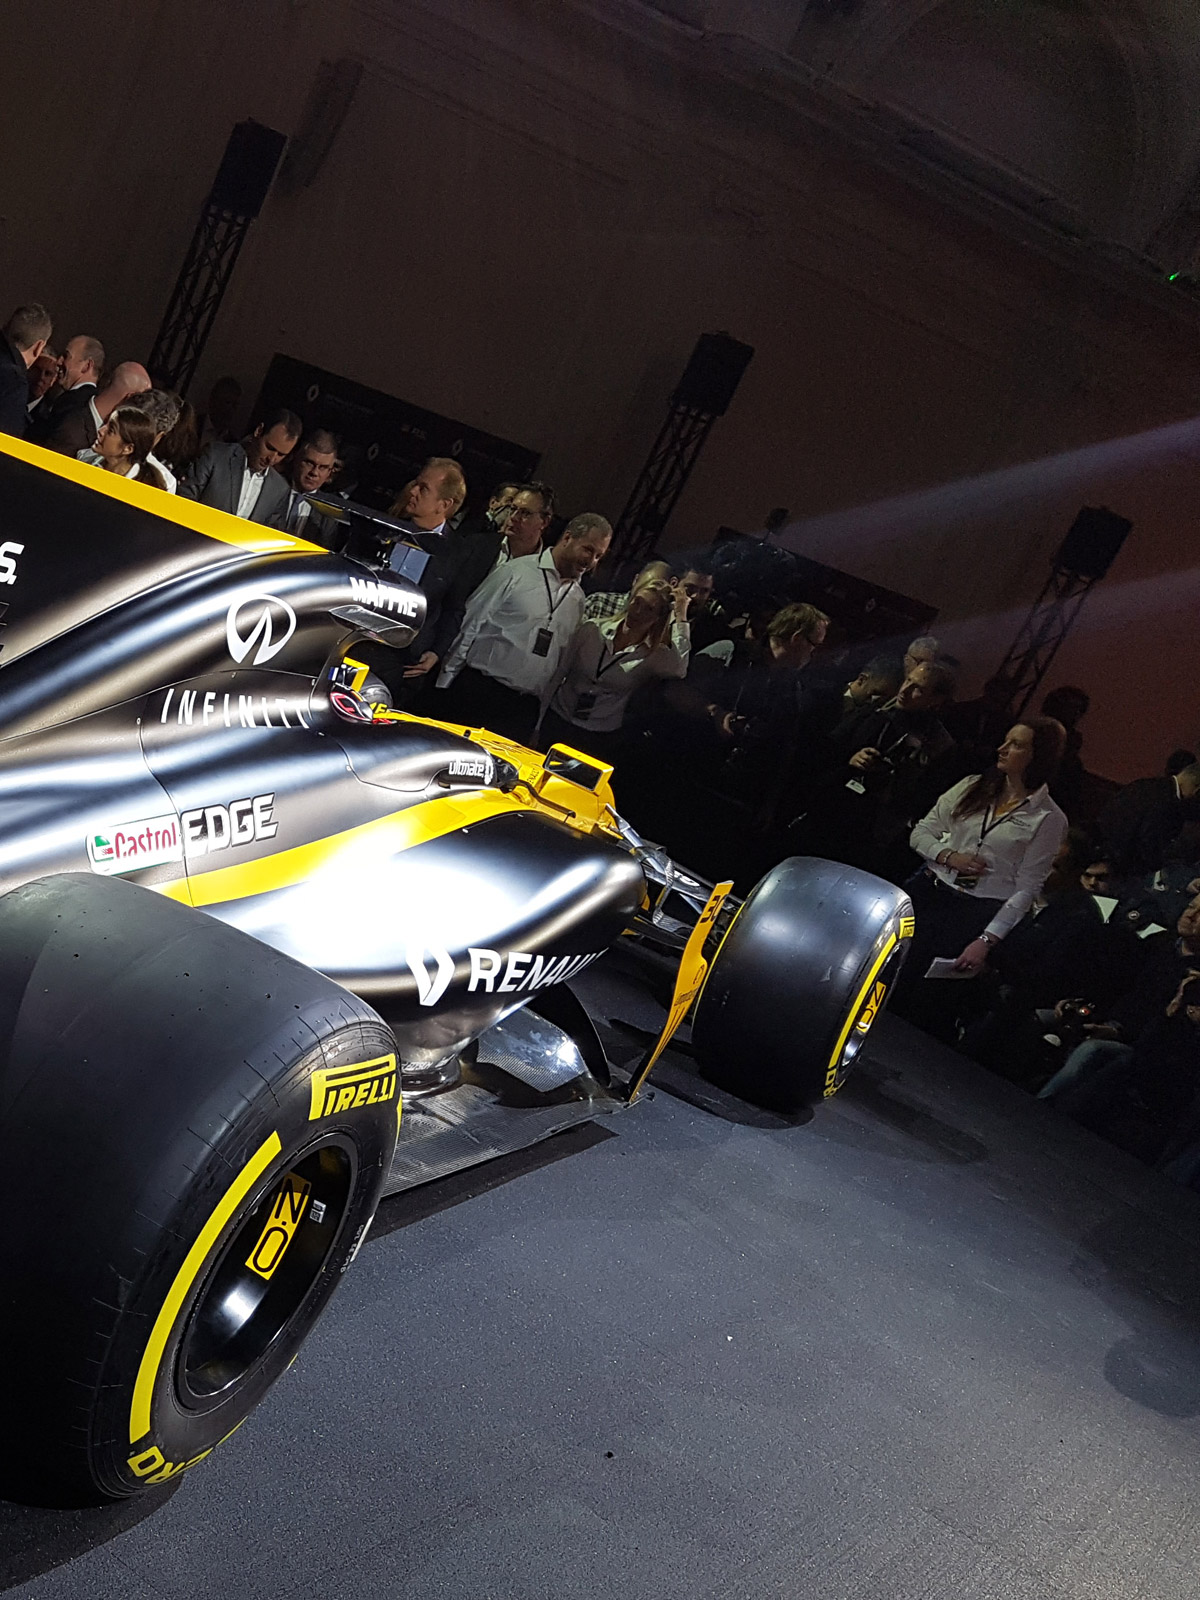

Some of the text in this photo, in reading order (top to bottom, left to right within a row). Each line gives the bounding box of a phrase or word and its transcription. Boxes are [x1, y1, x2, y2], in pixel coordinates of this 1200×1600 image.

[349, 576, 418, 618] MAPFRE
[161, 688, 309, 728] INFINITI
[115, 792, 279, 859] Castrol EDGE
[308, 1053, 397, 1121] PIRELLI
